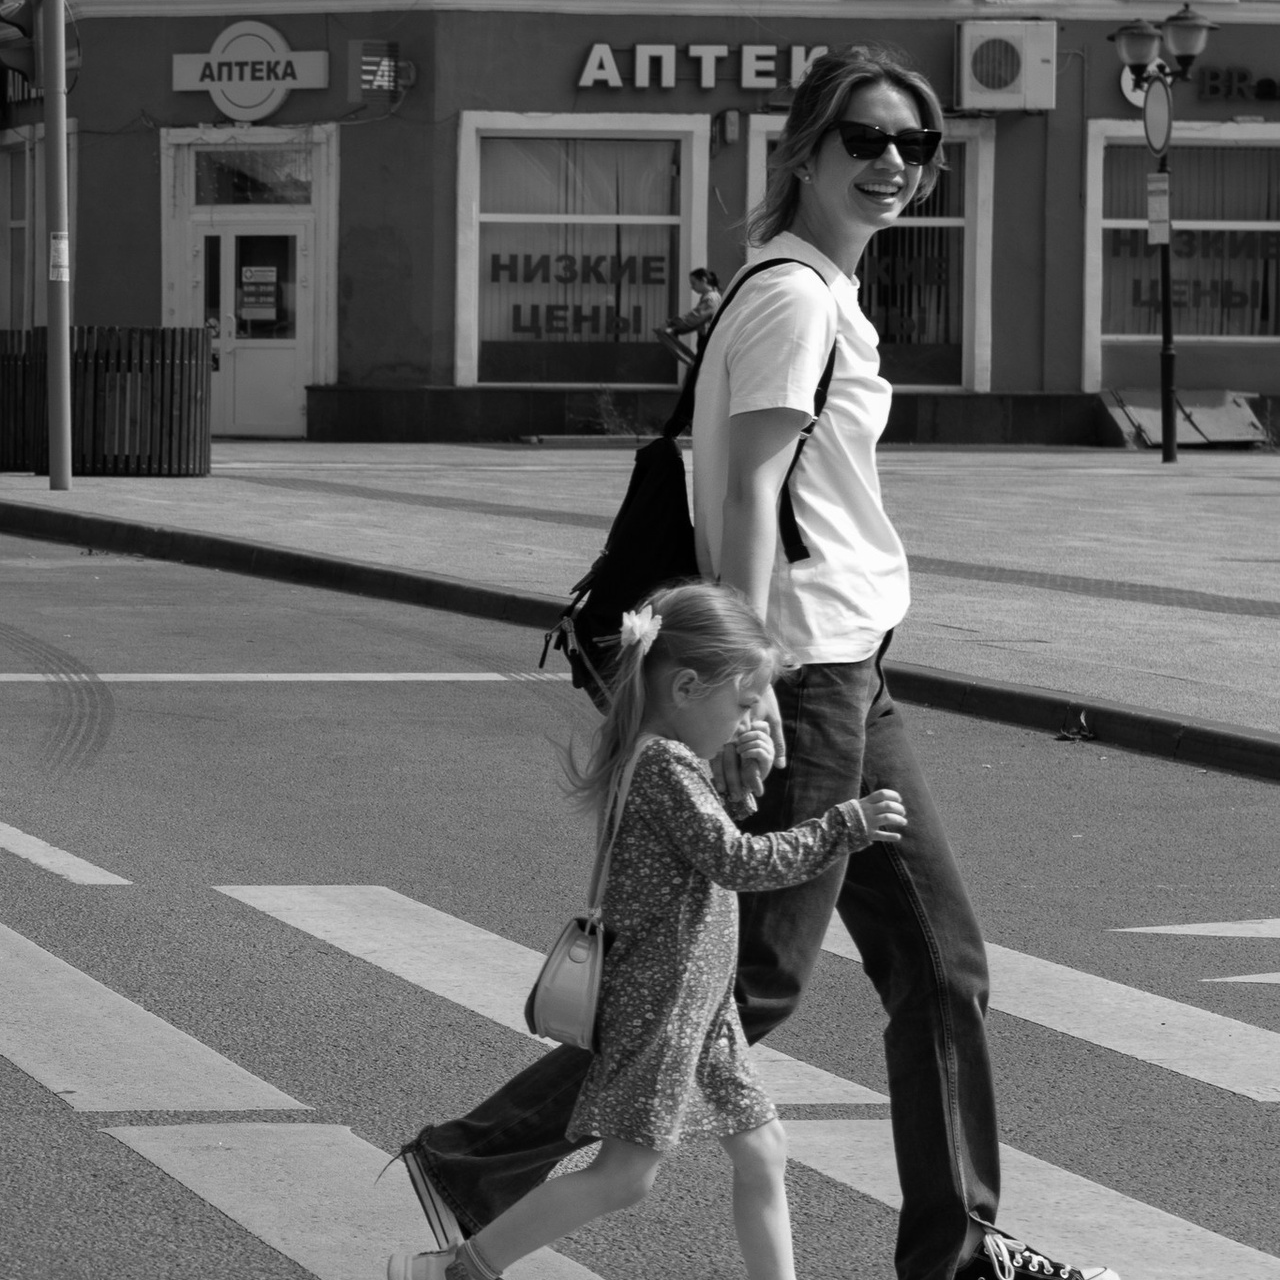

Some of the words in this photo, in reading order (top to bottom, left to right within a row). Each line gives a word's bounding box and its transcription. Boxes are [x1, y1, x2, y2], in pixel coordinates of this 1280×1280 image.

[199, 59, 297, 83] АПТЕКА
[578, 43, 871, 90] АПТЕК
[490, 254, 667, 285] НИЗКИЕ
[1132, 279, 1260, 313] ЦЕНЫ
[512, 304, 643, 339] ЦЕНЫ
